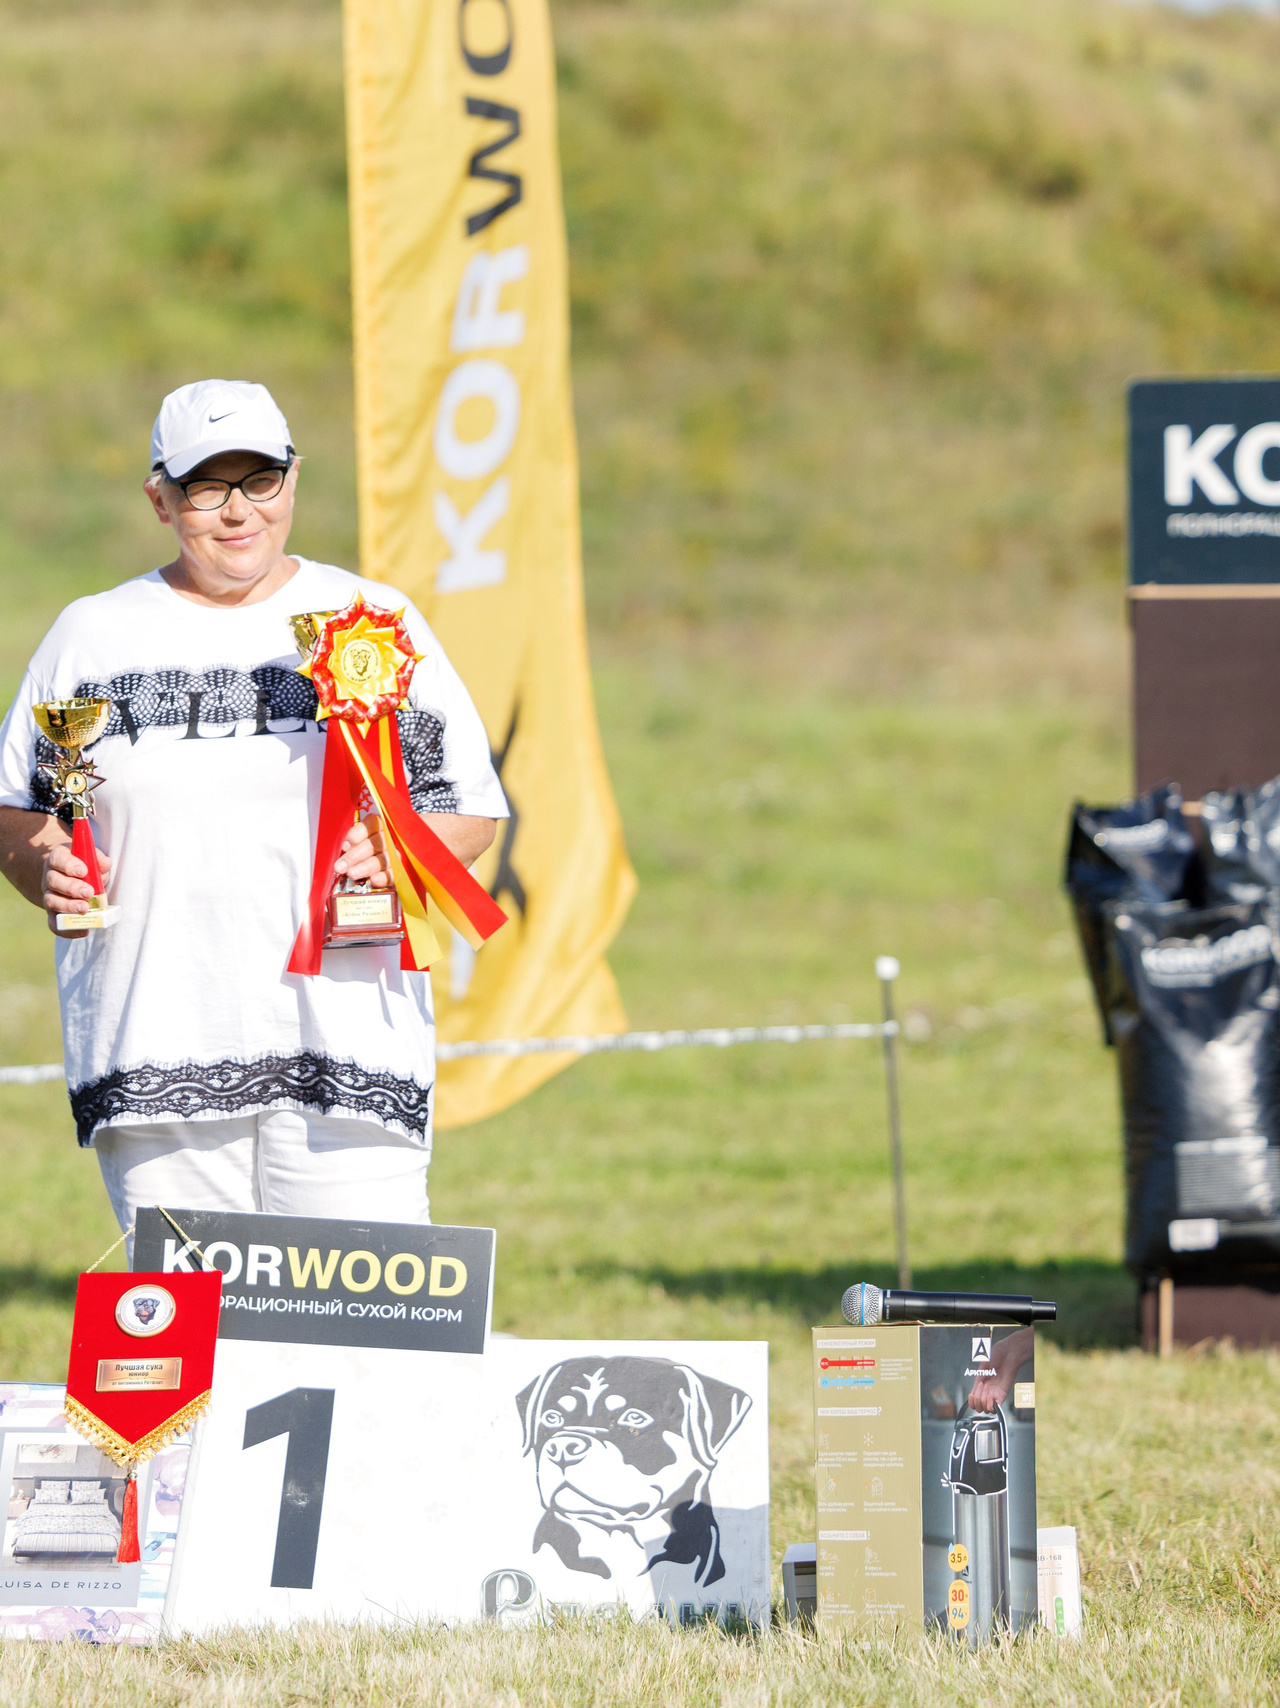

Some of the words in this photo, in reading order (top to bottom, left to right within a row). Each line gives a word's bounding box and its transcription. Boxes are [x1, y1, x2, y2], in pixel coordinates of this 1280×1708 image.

[161, 1238, 468, 1297] KORWOOD
[346, 1302, 406, 1320] СУХОЙ
[410, 1306, 463, 1323] КОРМ
[242, 1387, 335, 1590] 1
[51, 1581, 70, 1589] DE
[77, 1582, 122, 1590] RIZZO
[951, 1589, 965, 1602] 30
